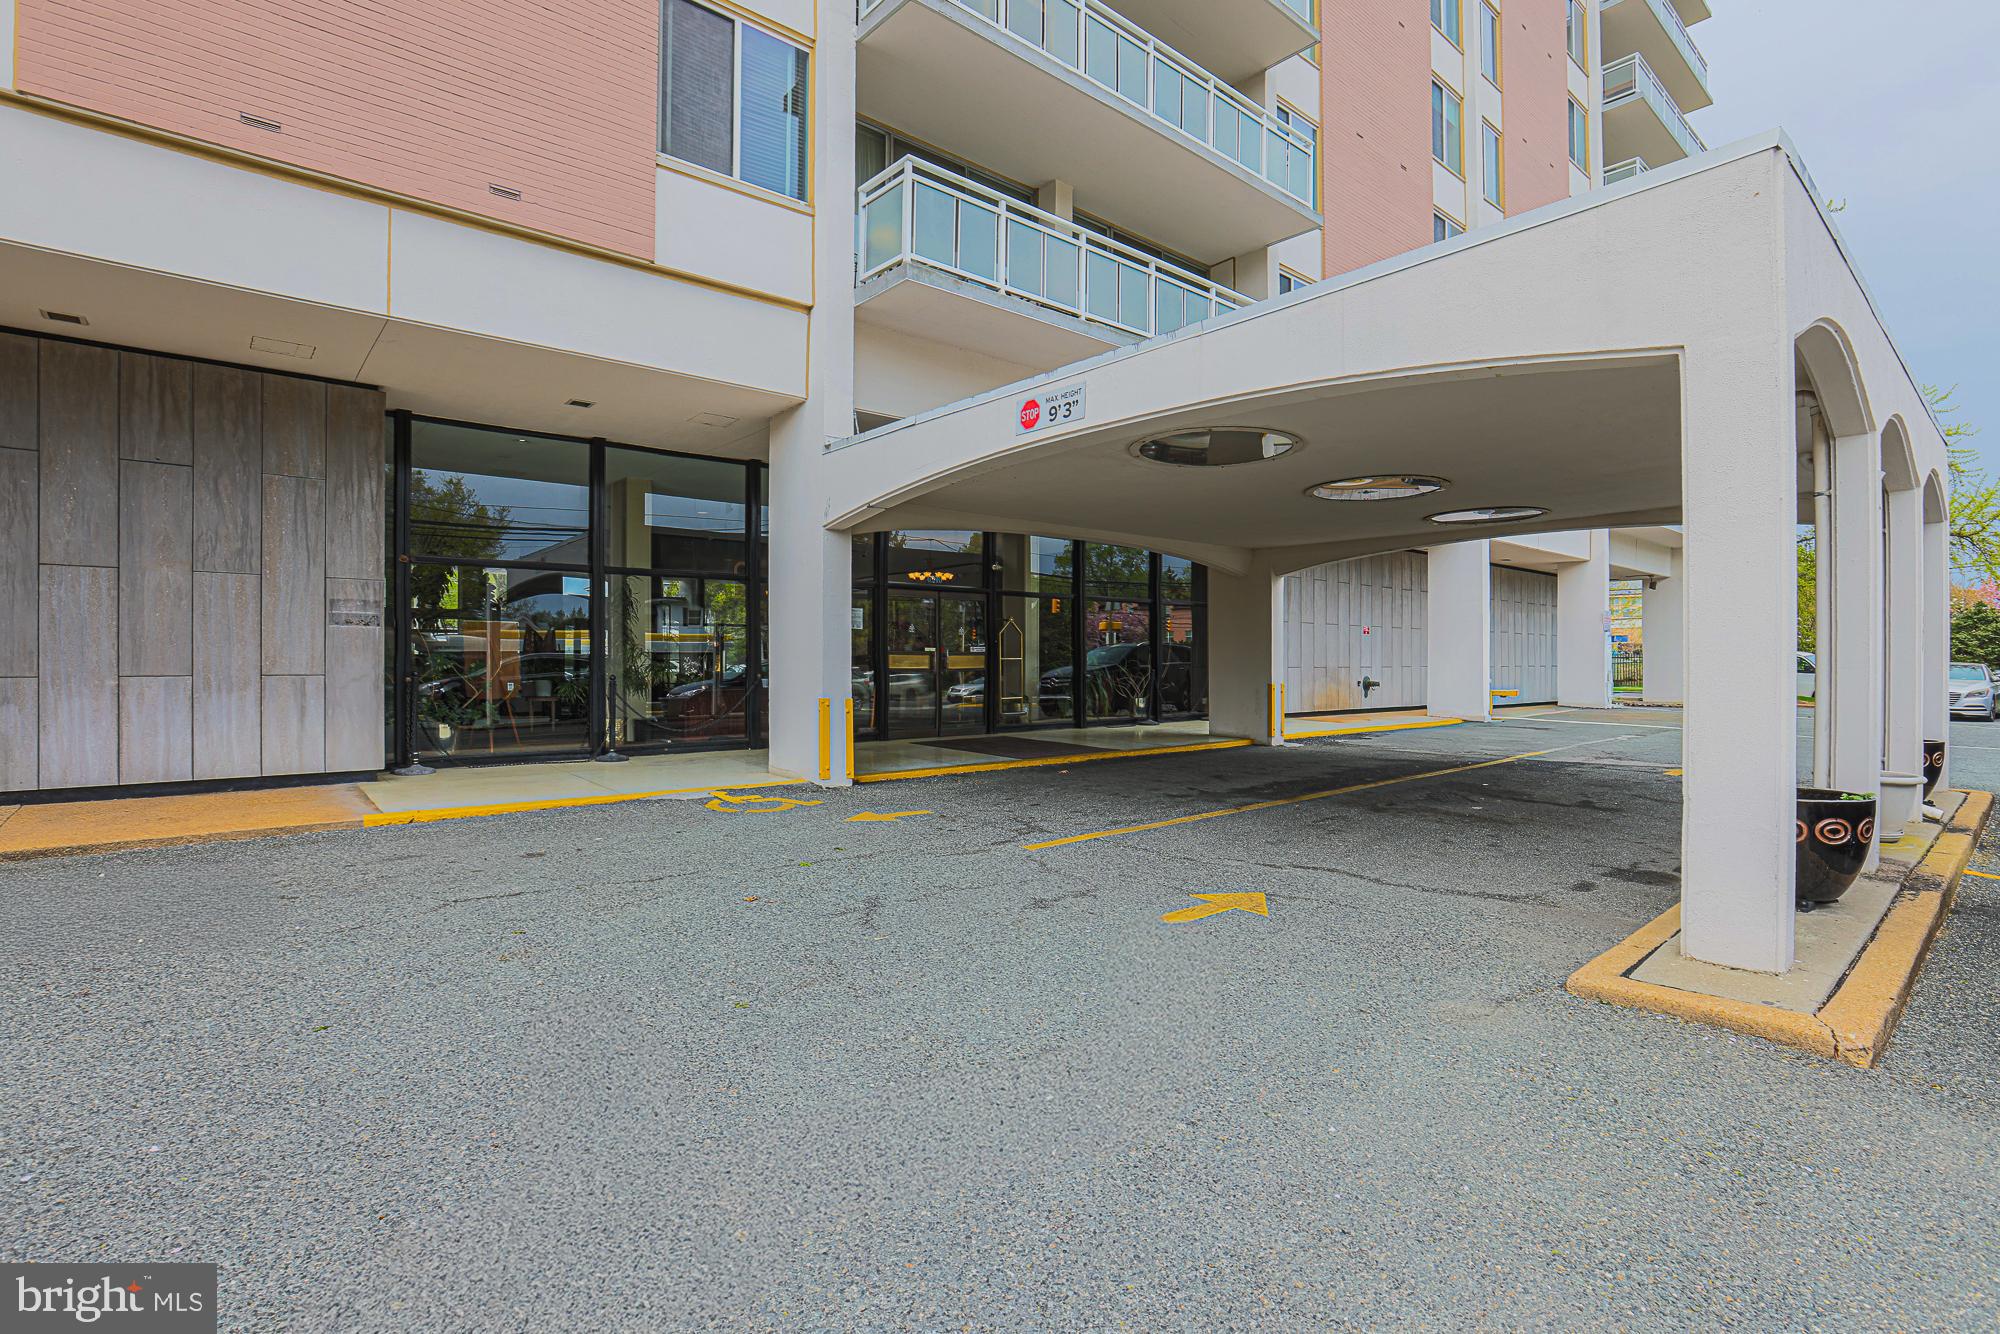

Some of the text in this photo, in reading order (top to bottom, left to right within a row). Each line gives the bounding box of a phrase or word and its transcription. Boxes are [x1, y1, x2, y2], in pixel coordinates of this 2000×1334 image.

[1046, 388, 1082, 403] MAX HEIGHT
[1021, 407, 1039, 422] STOP
